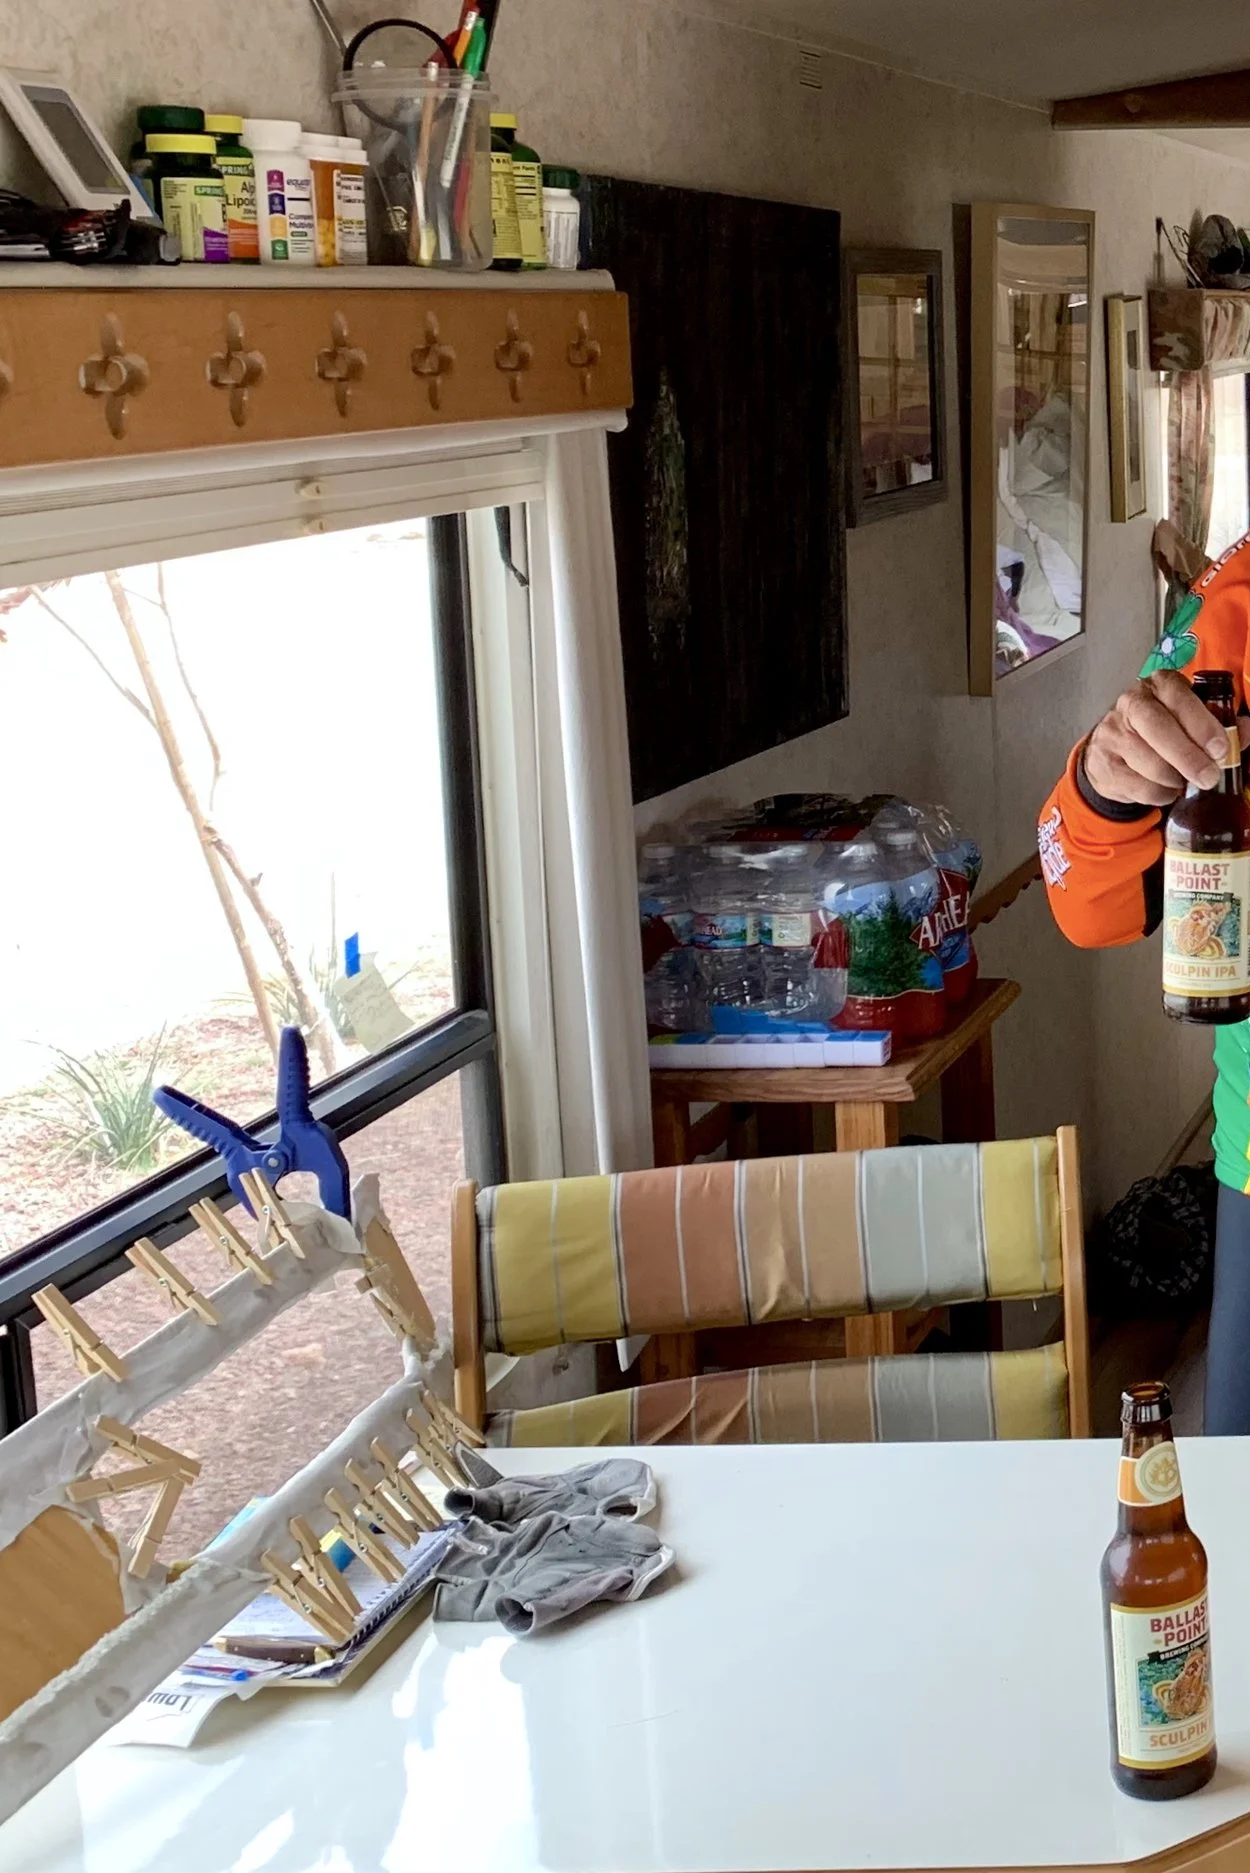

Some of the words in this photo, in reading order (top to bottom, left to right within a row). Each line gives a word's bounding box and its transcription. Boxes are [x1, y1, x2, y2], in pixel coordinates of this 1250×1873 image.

[1170, 860, 1230, 876] BALLAST
[1176, 876, 1222, 890] POINT
[1215, 965, 1237, 977] IPA
[1164, 1615, 1206, 1647] POINT
[1148, 1721, 1208, 1747] SCULPIN
